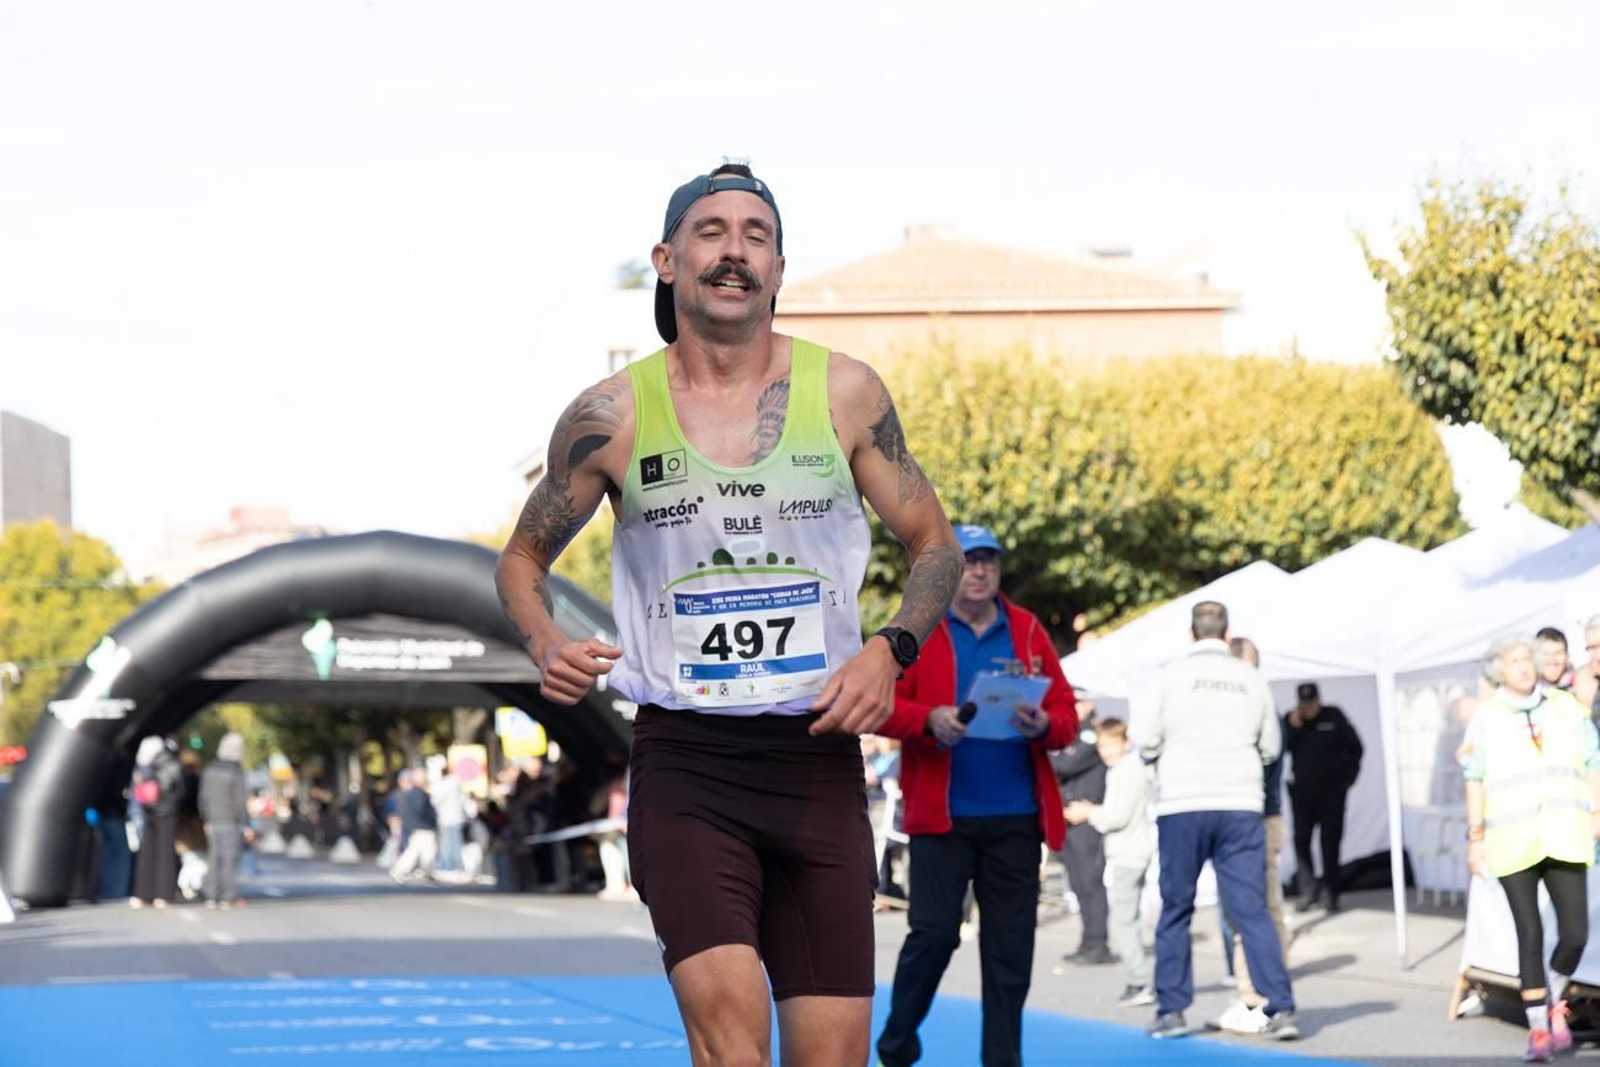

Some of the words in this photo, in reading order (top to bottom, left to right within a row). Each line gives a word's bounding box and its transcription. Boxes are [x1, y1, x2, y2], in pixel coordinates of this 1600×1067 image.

[646, 462, 657, 477] H
[667, 457, 680, 471] O
[716, 480, 766, 498] vive
[643, 497, 699, 523] atracón
[700, 616, 796, 662] 497
